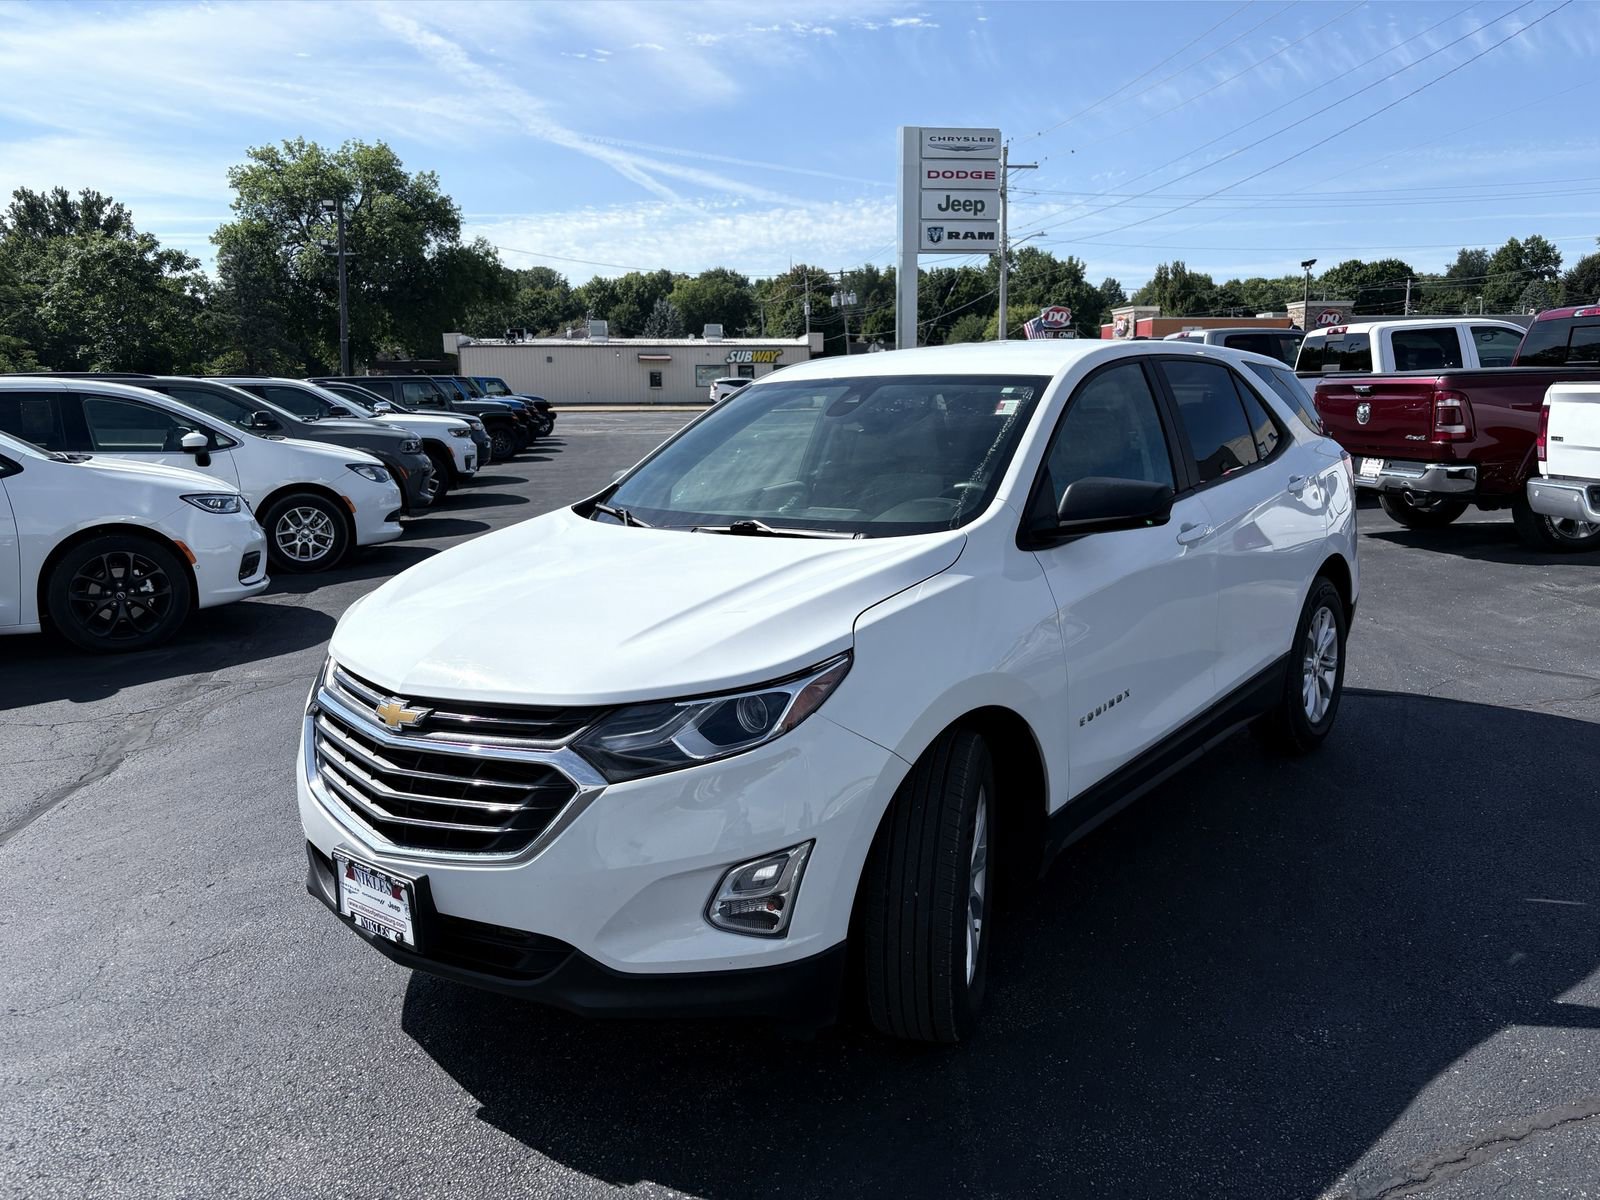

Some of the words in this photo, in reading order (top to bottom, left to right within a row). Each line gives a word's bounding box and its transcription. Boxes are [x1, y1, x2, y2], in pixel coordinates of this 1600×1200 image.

[927, 170, 996, 180] DODGE
[937, 194, 986, 216] Jeep
[947, 231, 995, 241] RAM
[1047, 311, 1068, 322] DQ
[1320, 313, 1340, 325] DQ
[726, 350, 782, 363] SUBWAY
[1079, 688, 1130, 728] EQUINOX
[354, 867, 392, 897] NIKLES
[360, 916, 391, 939] NIKLES
